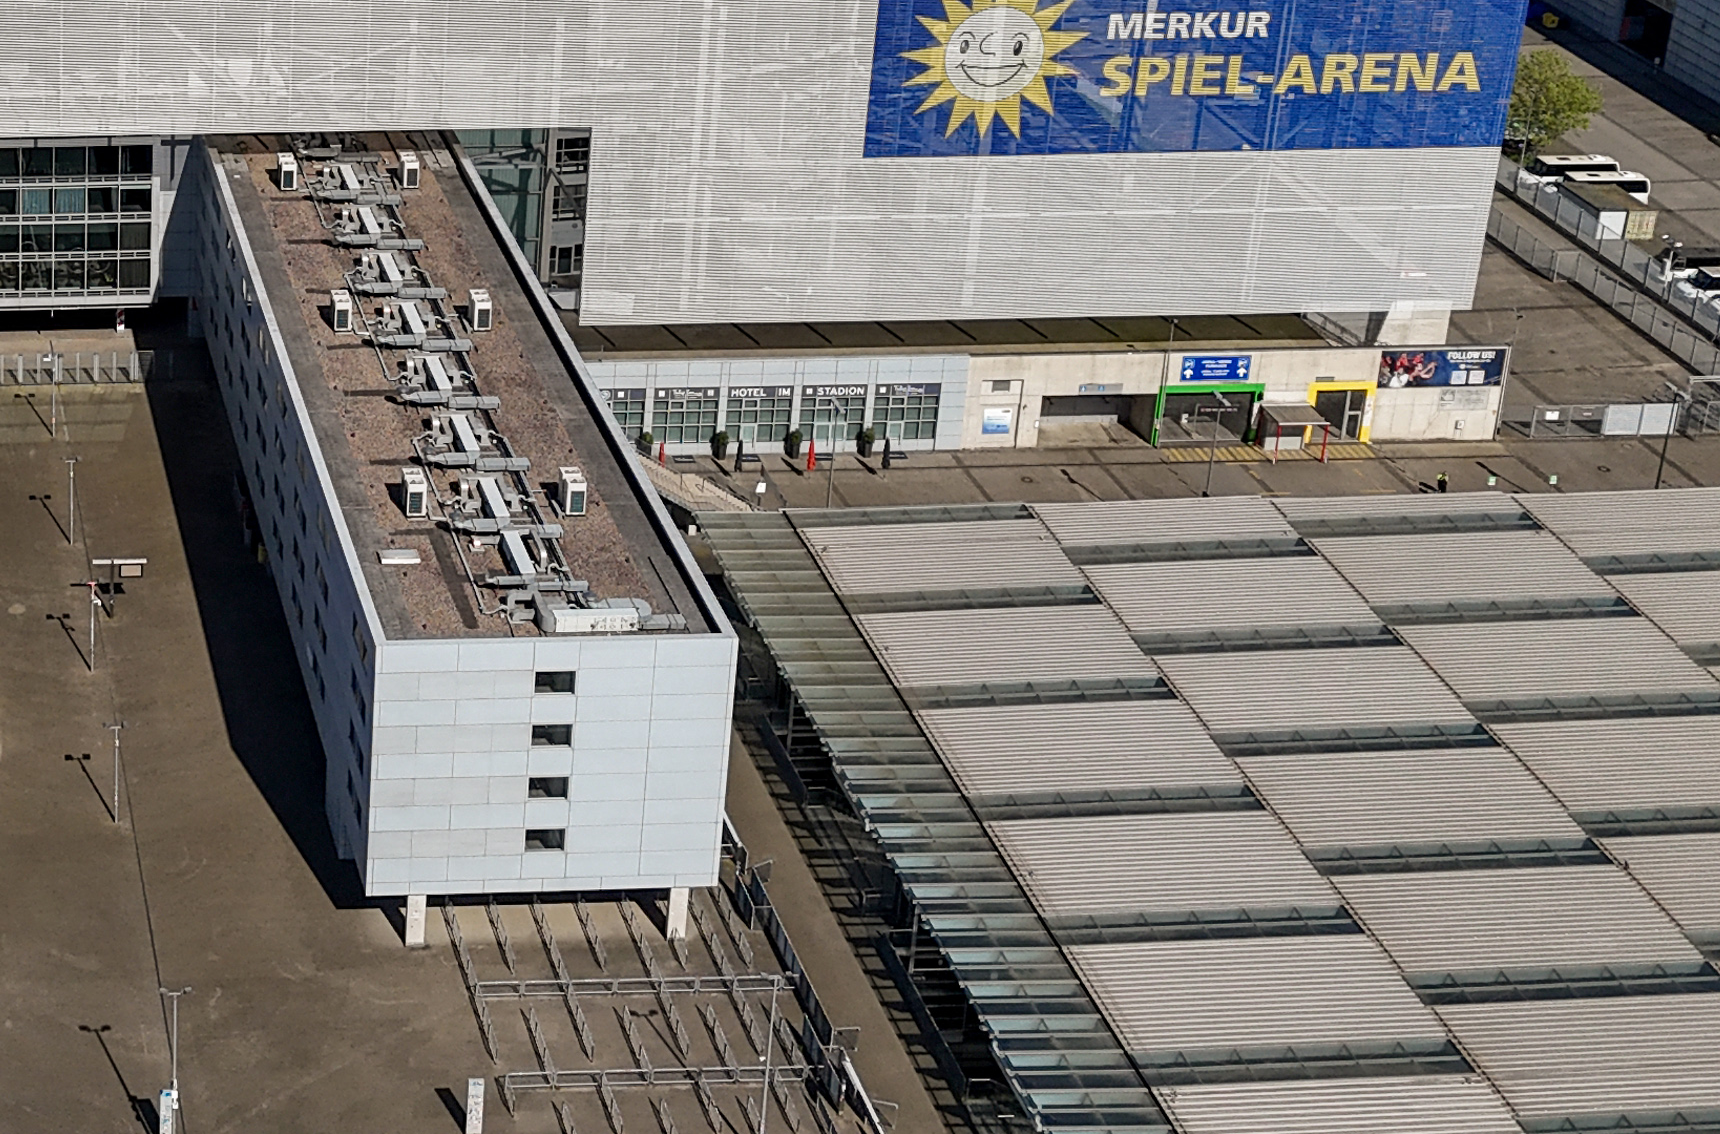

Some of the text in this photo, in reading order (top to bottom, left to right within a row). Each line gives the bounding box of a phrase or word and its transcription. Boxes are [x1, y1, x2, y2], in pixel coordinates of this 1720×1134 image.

[1106, 11, 1271, 40] MERKUR
[1100, 51, 1481, 97] SPIEL-ARENA
[1447, 351, 1480, 360] FOLLOW
[730, 386, 865, 397] HOTEL IM STADION
